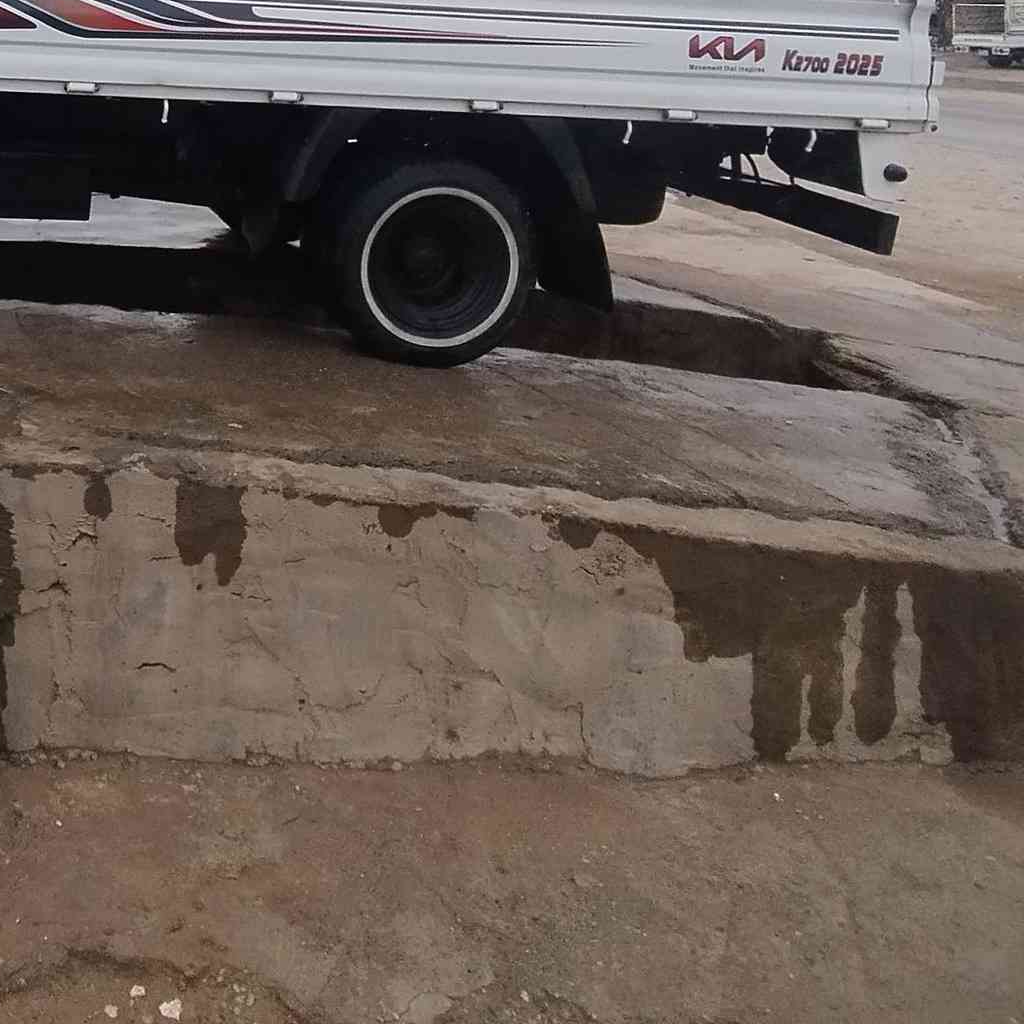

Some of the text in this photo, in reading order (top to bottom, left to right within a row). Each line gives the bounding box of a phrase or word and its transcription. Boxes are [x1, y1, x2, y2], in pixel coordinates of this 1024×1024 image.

[688, 34, 766, 63] KIA
[781, 49, 885, 76] K2700 2025
